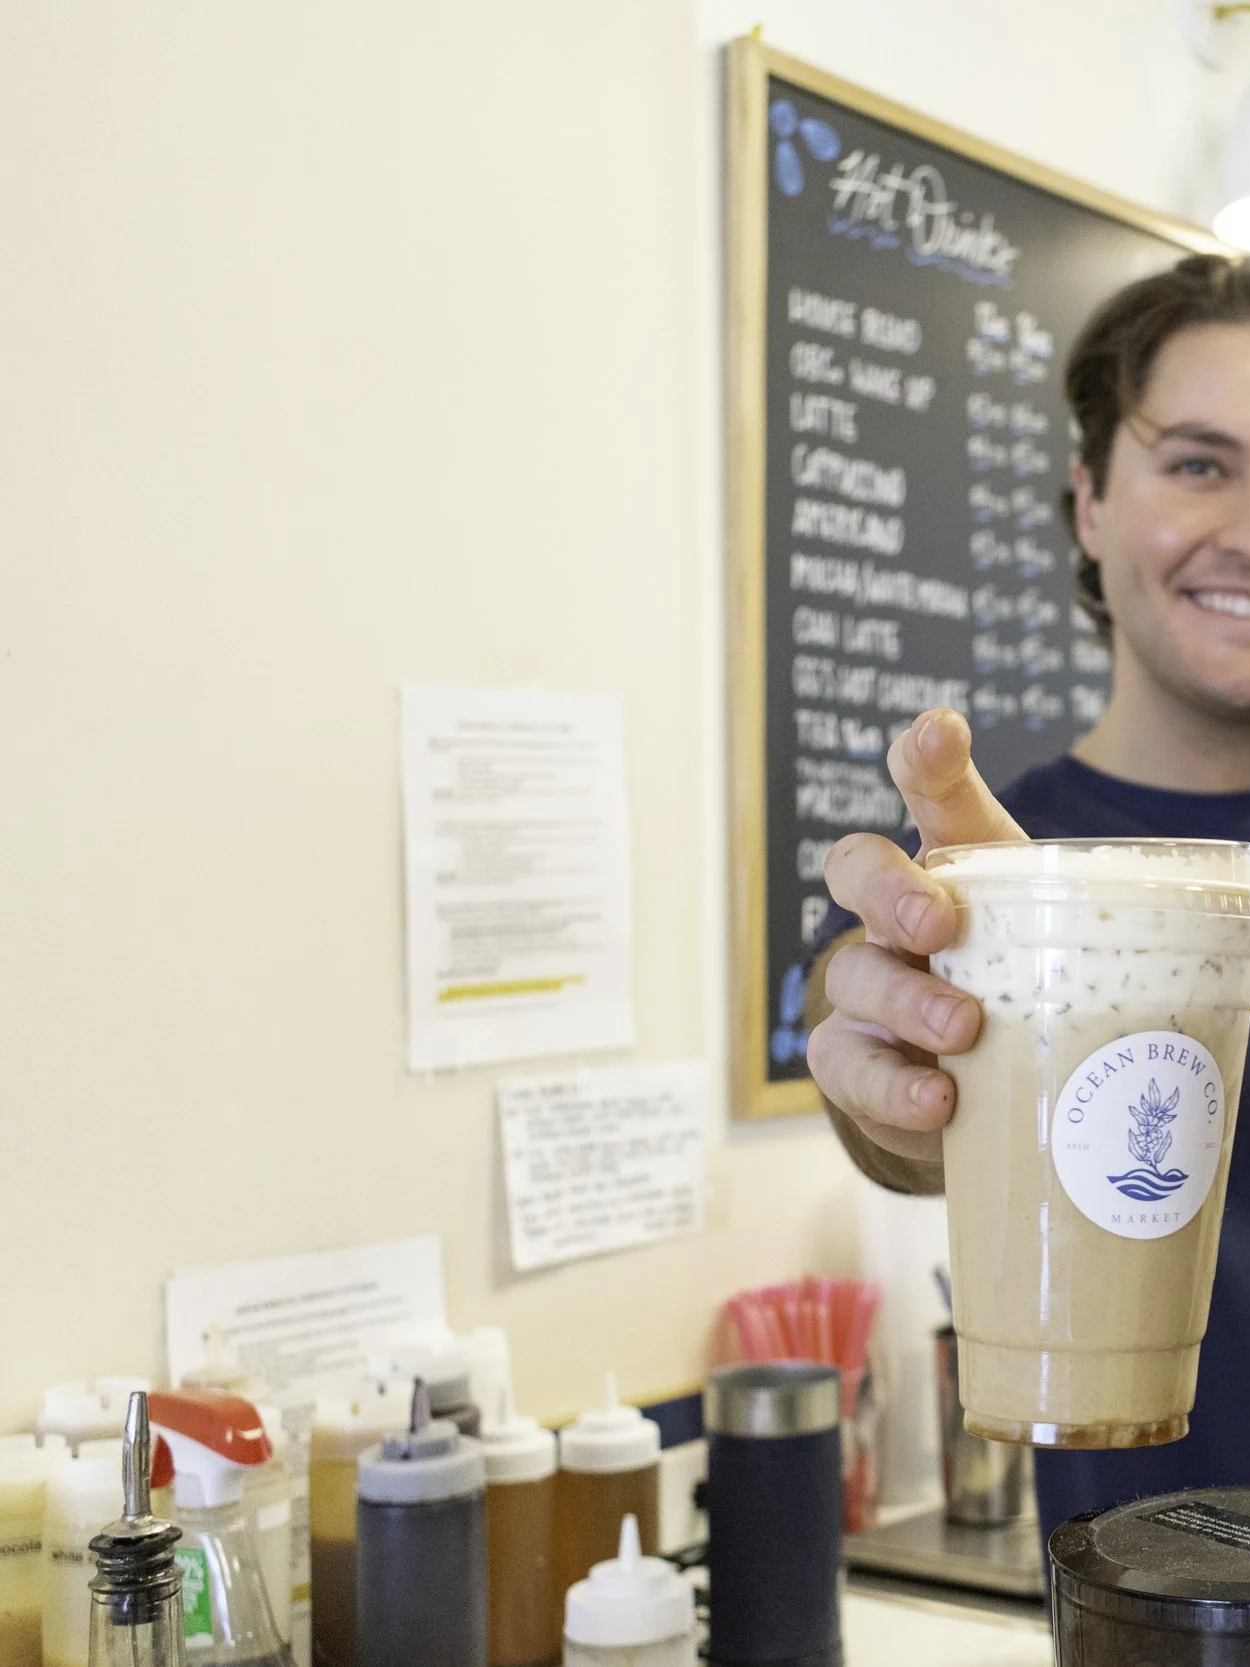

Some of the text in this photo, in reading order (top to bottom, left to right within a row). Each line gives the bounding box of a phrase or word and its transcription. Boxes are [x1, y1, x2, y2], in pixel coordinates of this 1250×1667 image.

[829, 150, 906, 231] Hot
[789, 392, 858, 443] LATTE
[841, 616, 900, 661] LATTE
[1068, 1043, 1218, 1125] OCEAN BREW CO.
[1111, 1212, 1180, 1224] MARKET
